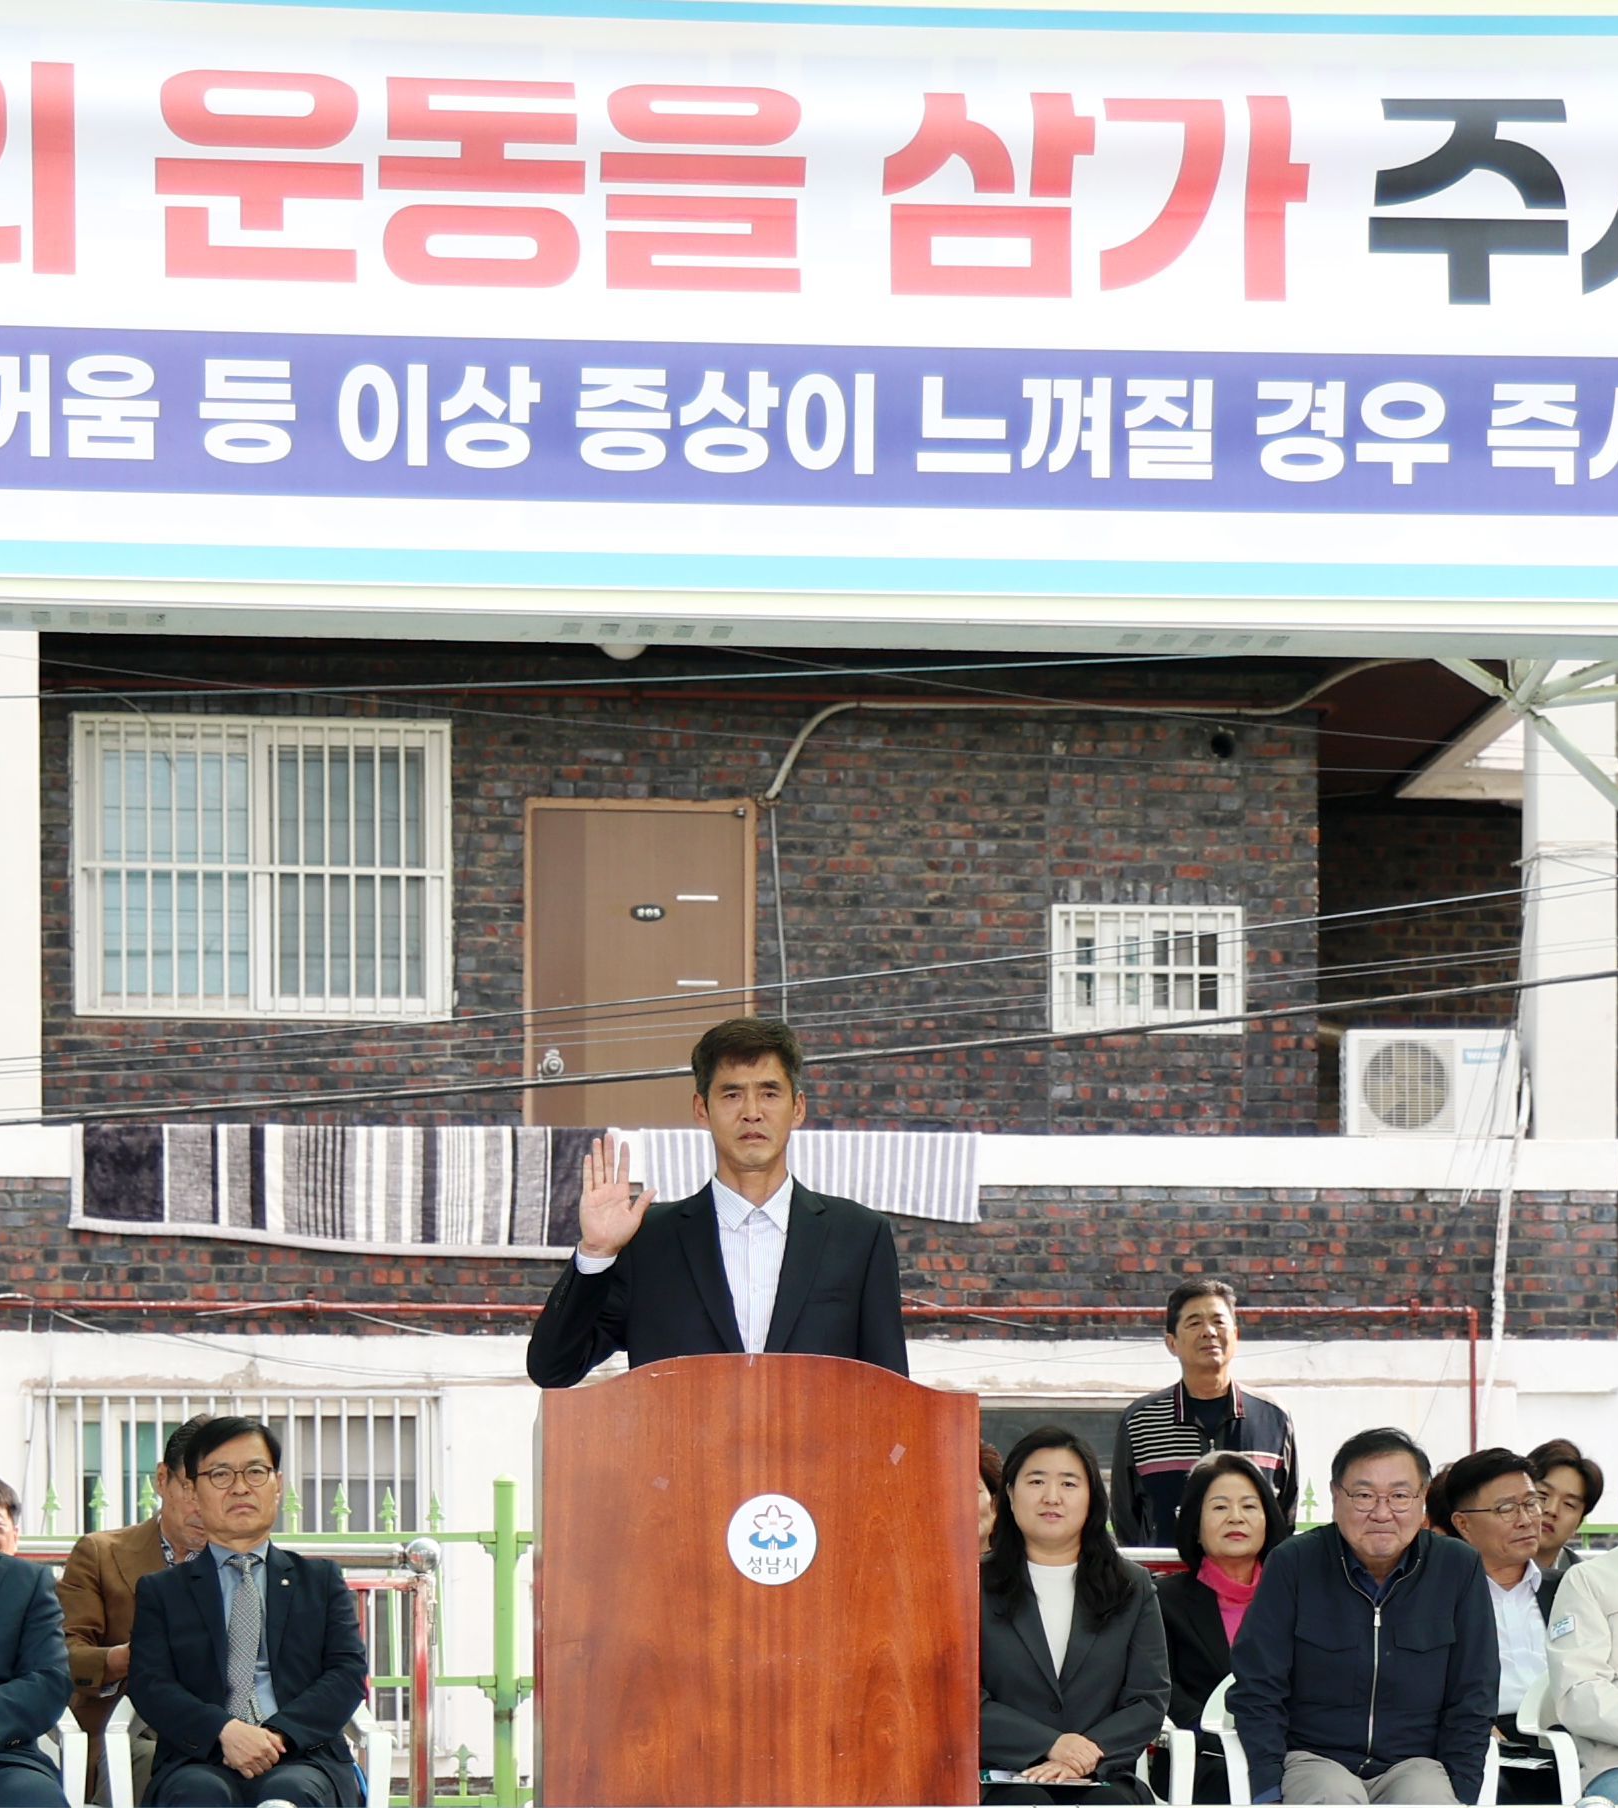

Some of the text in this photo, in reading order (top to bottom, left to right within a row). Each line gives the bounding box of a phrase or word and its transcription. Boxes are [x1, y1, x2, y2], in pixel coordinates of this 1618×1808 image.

[155, 69, 806, 292] 운동을
[883, 92, 1310, 301] 삼가
[199, 359, 296, 463] 등
[338, 364, 541, 469] 이상
[576, 367, 875, 474] 증상이
[917, 376, 1214, 479] 느껴질
[1256, 381, 1450, 484] 경우
[747, 1556, 798, 1575] 성남시
